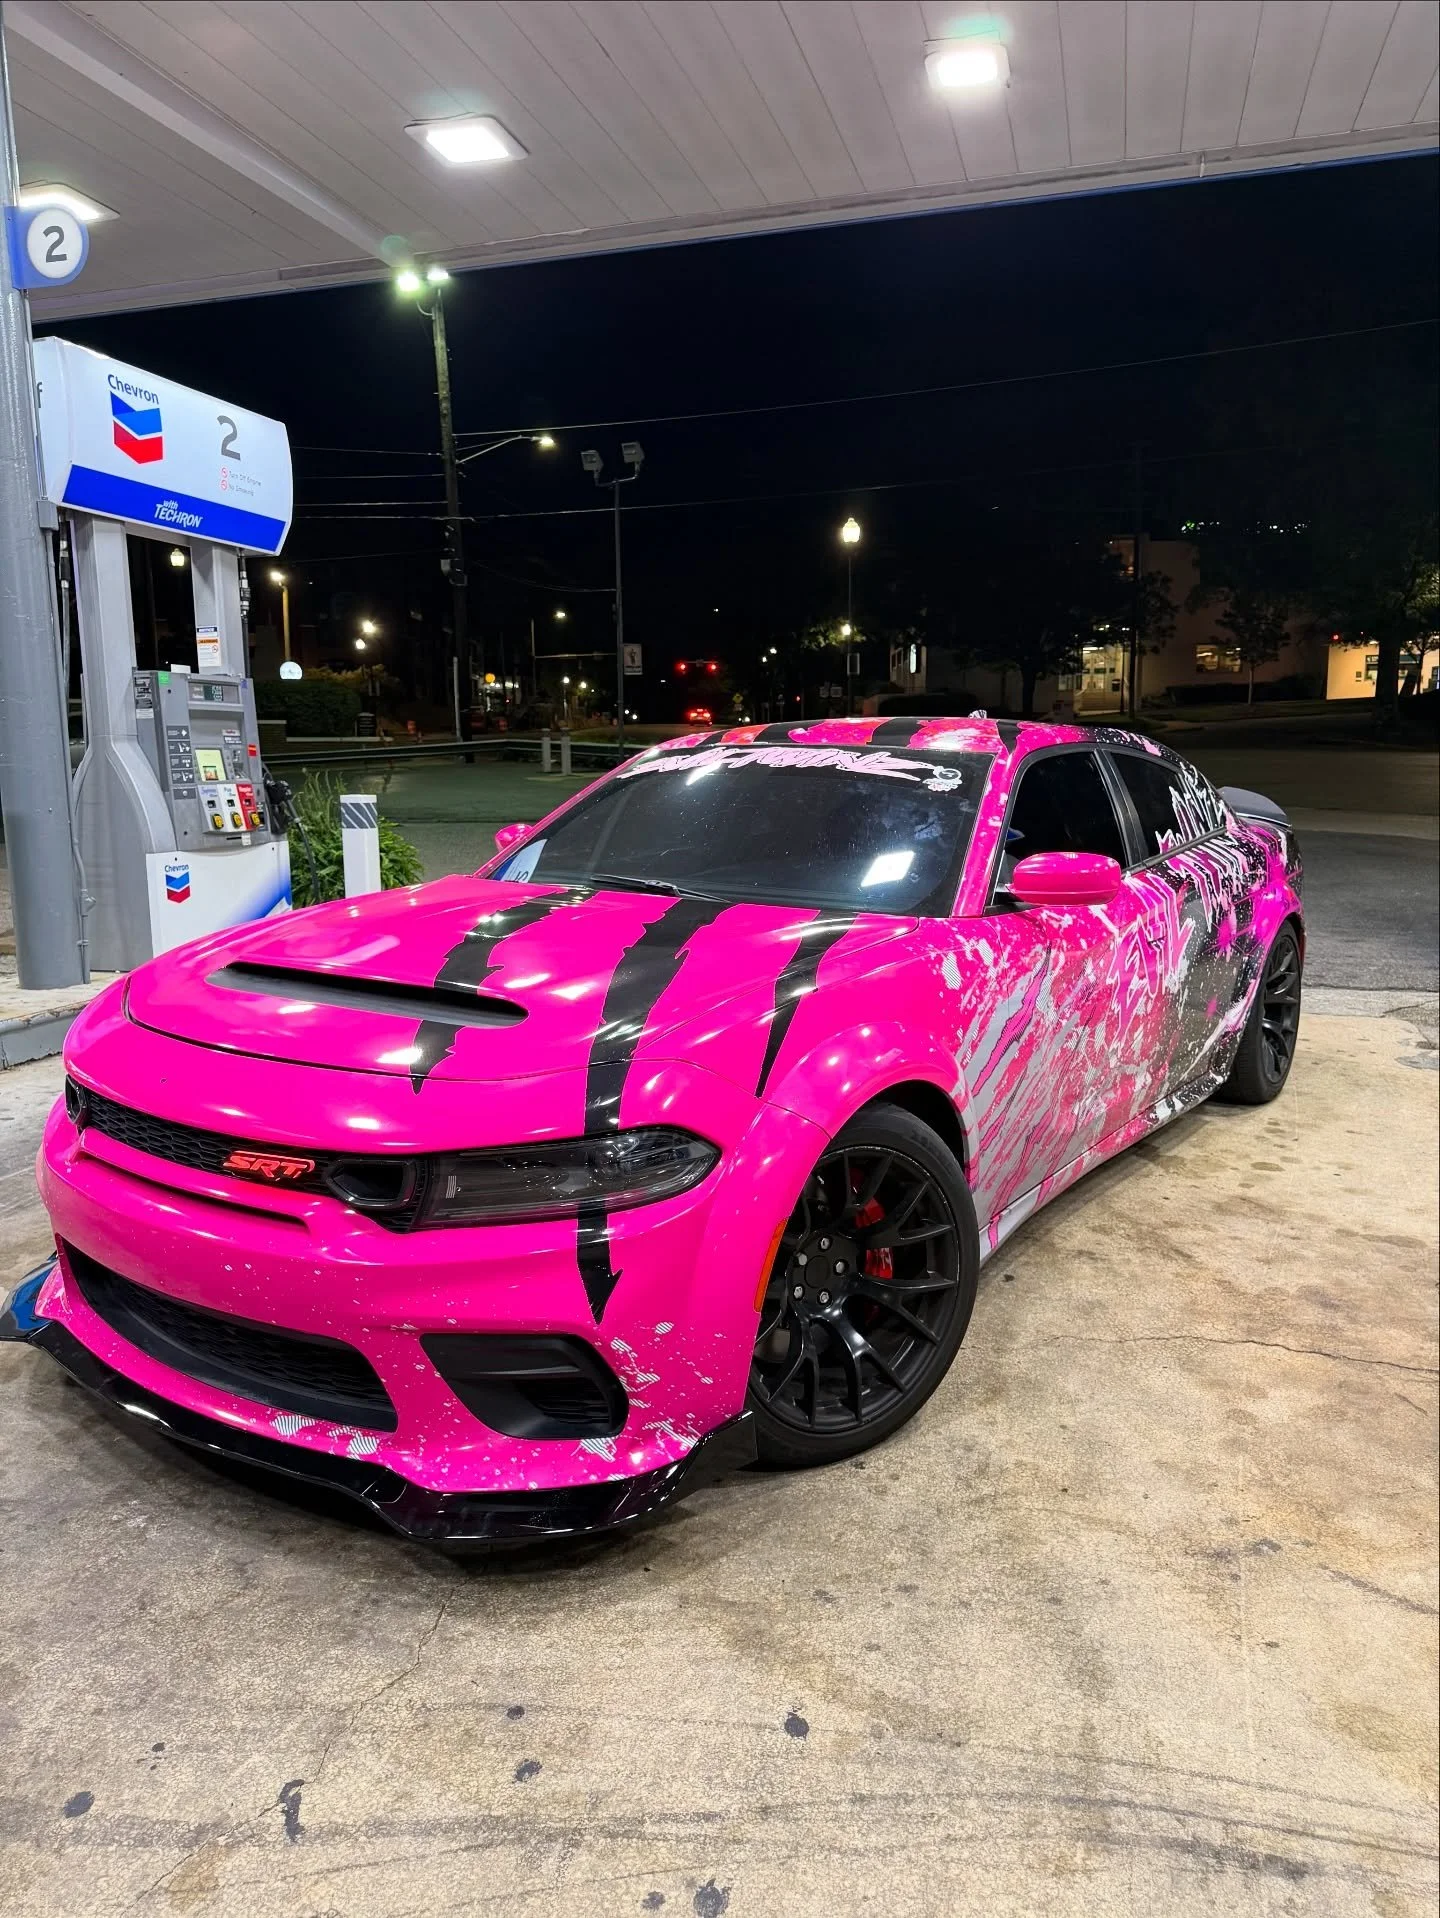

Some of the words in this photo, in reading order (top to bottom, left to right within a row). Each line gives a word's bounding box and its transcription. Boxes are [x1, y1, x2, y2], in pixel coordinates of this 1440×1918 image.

[43, 225, 67, 263] 2
[107, 373, 160, 405] Chevron
[216, 414, 241, 461] 2
[154, 503, 203, 528] TECHRON
[163, 499, 179, 510] with
[165, 864, 189, 873] Chevron
[222, 1155, 308, 1178] SRT
